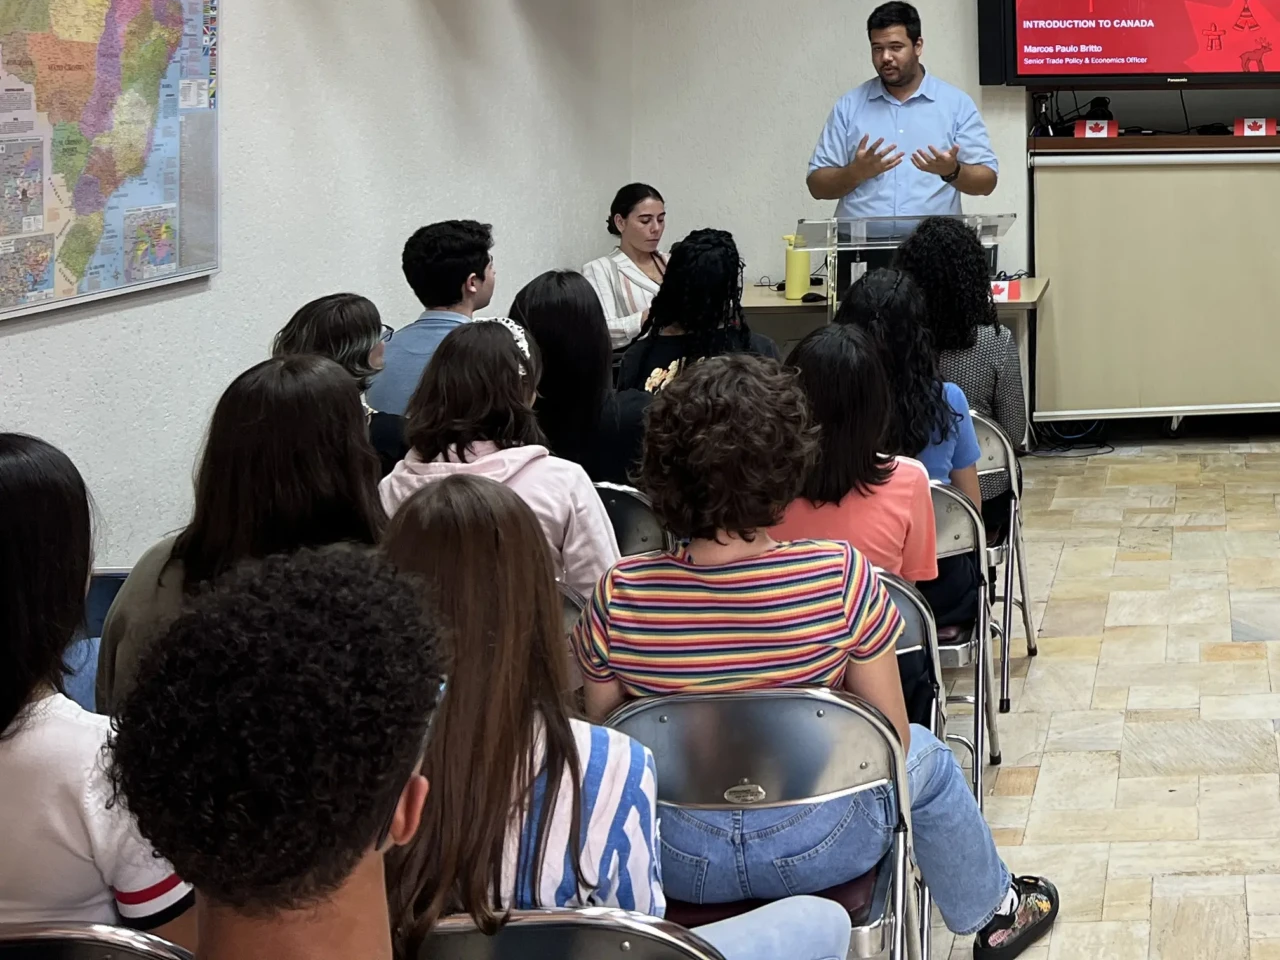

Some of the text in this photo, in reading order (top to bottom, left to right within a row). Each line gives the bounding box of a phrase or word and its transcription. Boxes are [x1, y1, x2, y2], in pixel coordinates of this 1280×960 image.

[1023, 19, 1154, 28] INTRODUCTION TO CANADA
[1024, 44, 1102, 53] Marcos Paulo Britto
[1065, 58, 1083, 66] Policy
